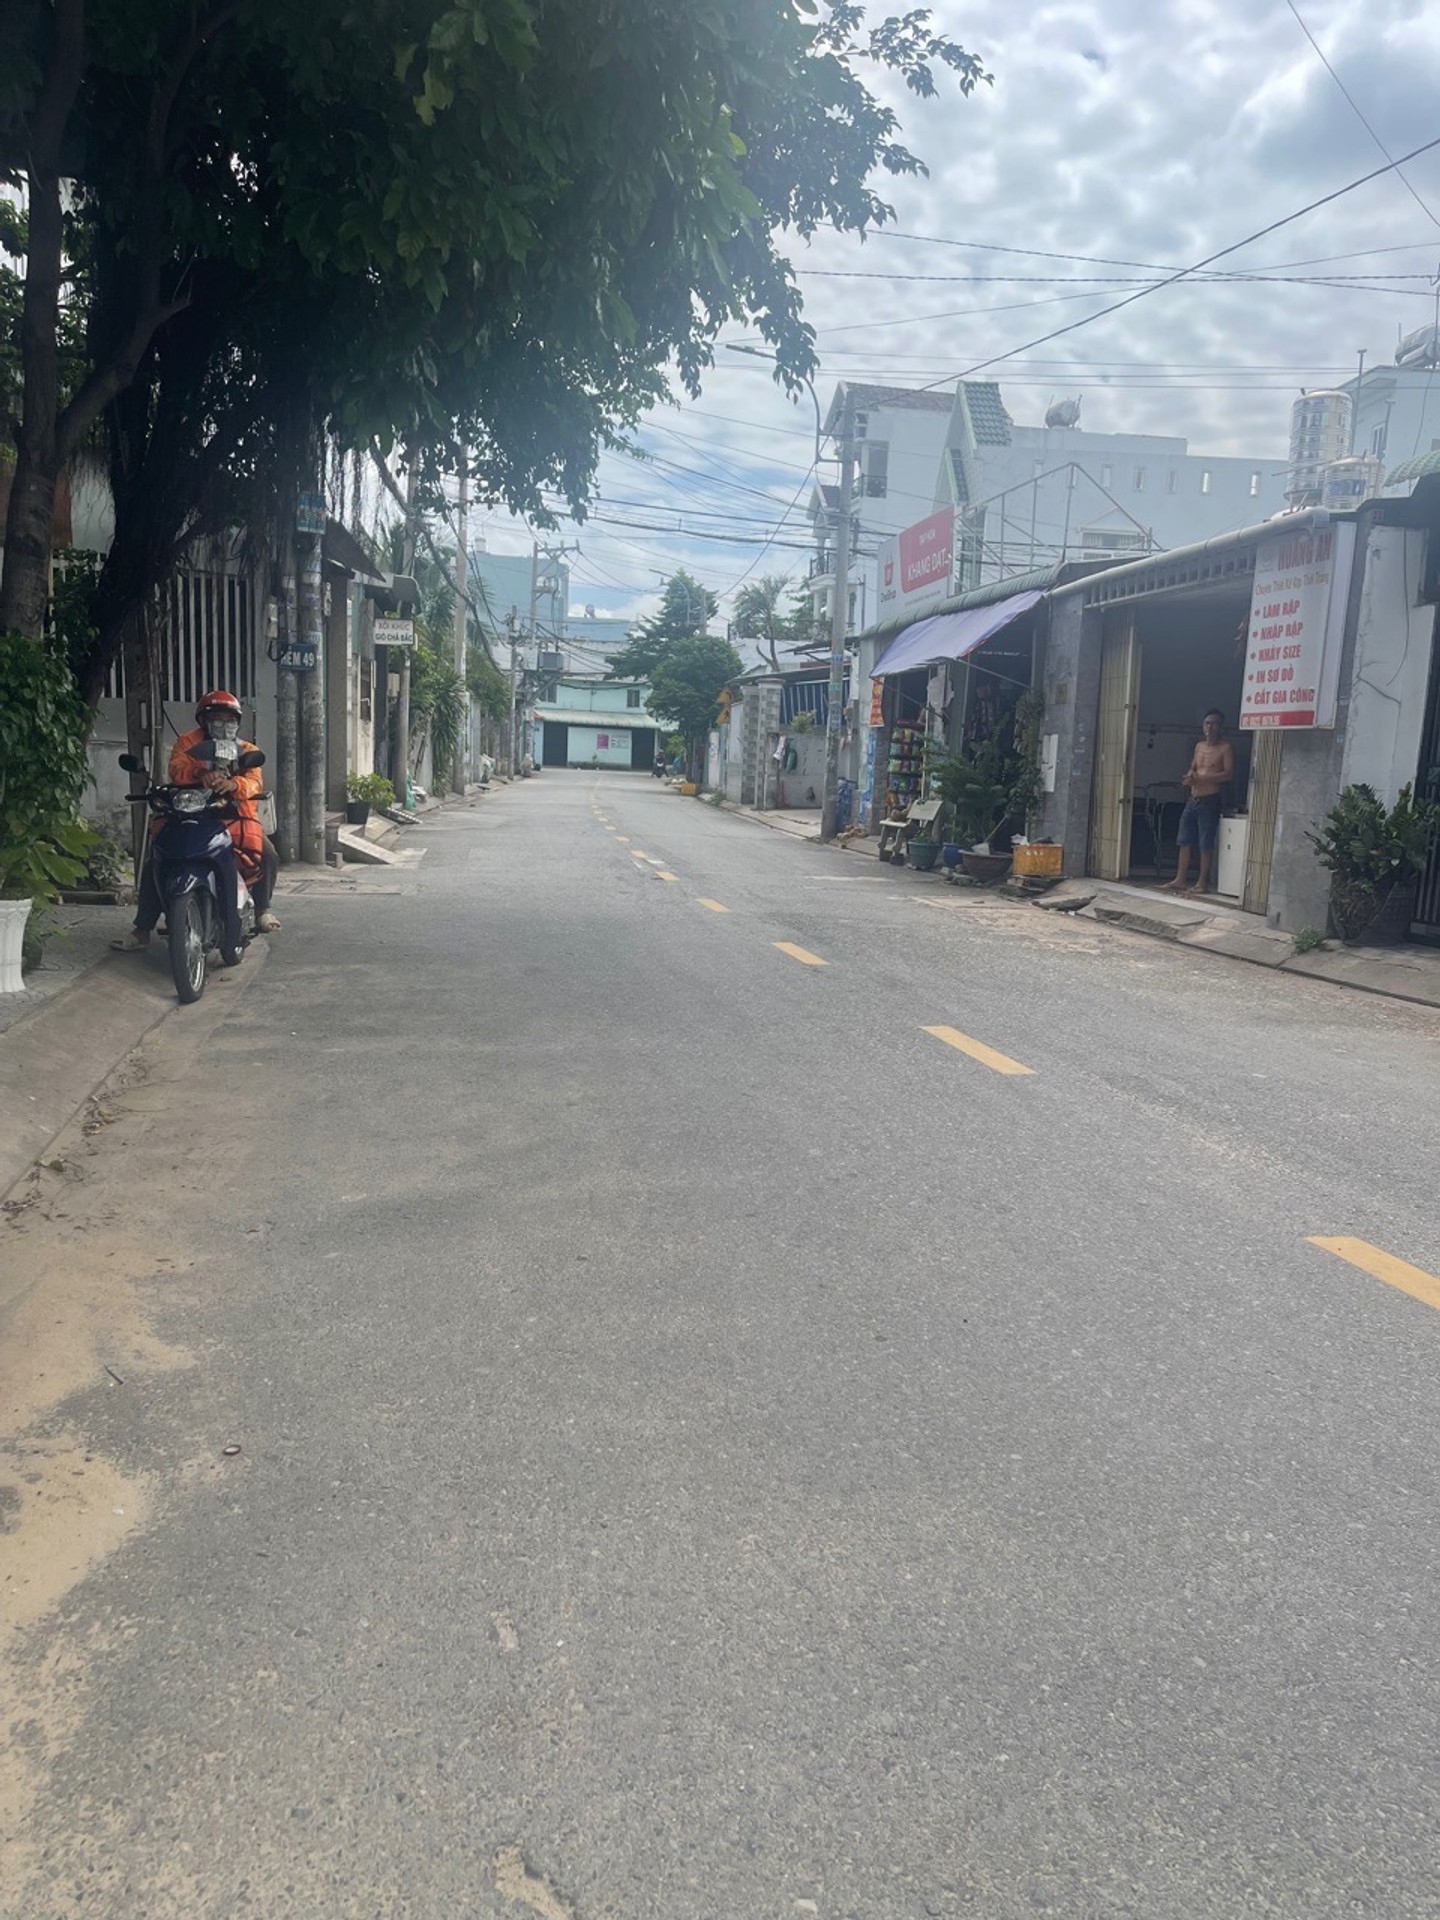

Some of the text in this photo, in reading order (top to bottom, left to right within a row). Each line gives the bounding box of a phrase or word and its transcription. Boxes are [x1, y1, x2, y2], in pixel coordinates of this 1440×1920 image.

[907, 555, 931, 581] KHANG
[303, 652, 315, 667] 49
[1283, 645, 1302, 660] SIZE
[1256, 670, 1265, 683] IN
[1273, 690, 1287, 704] GIA
[1289, 686, 1315, 703] CÔNG
